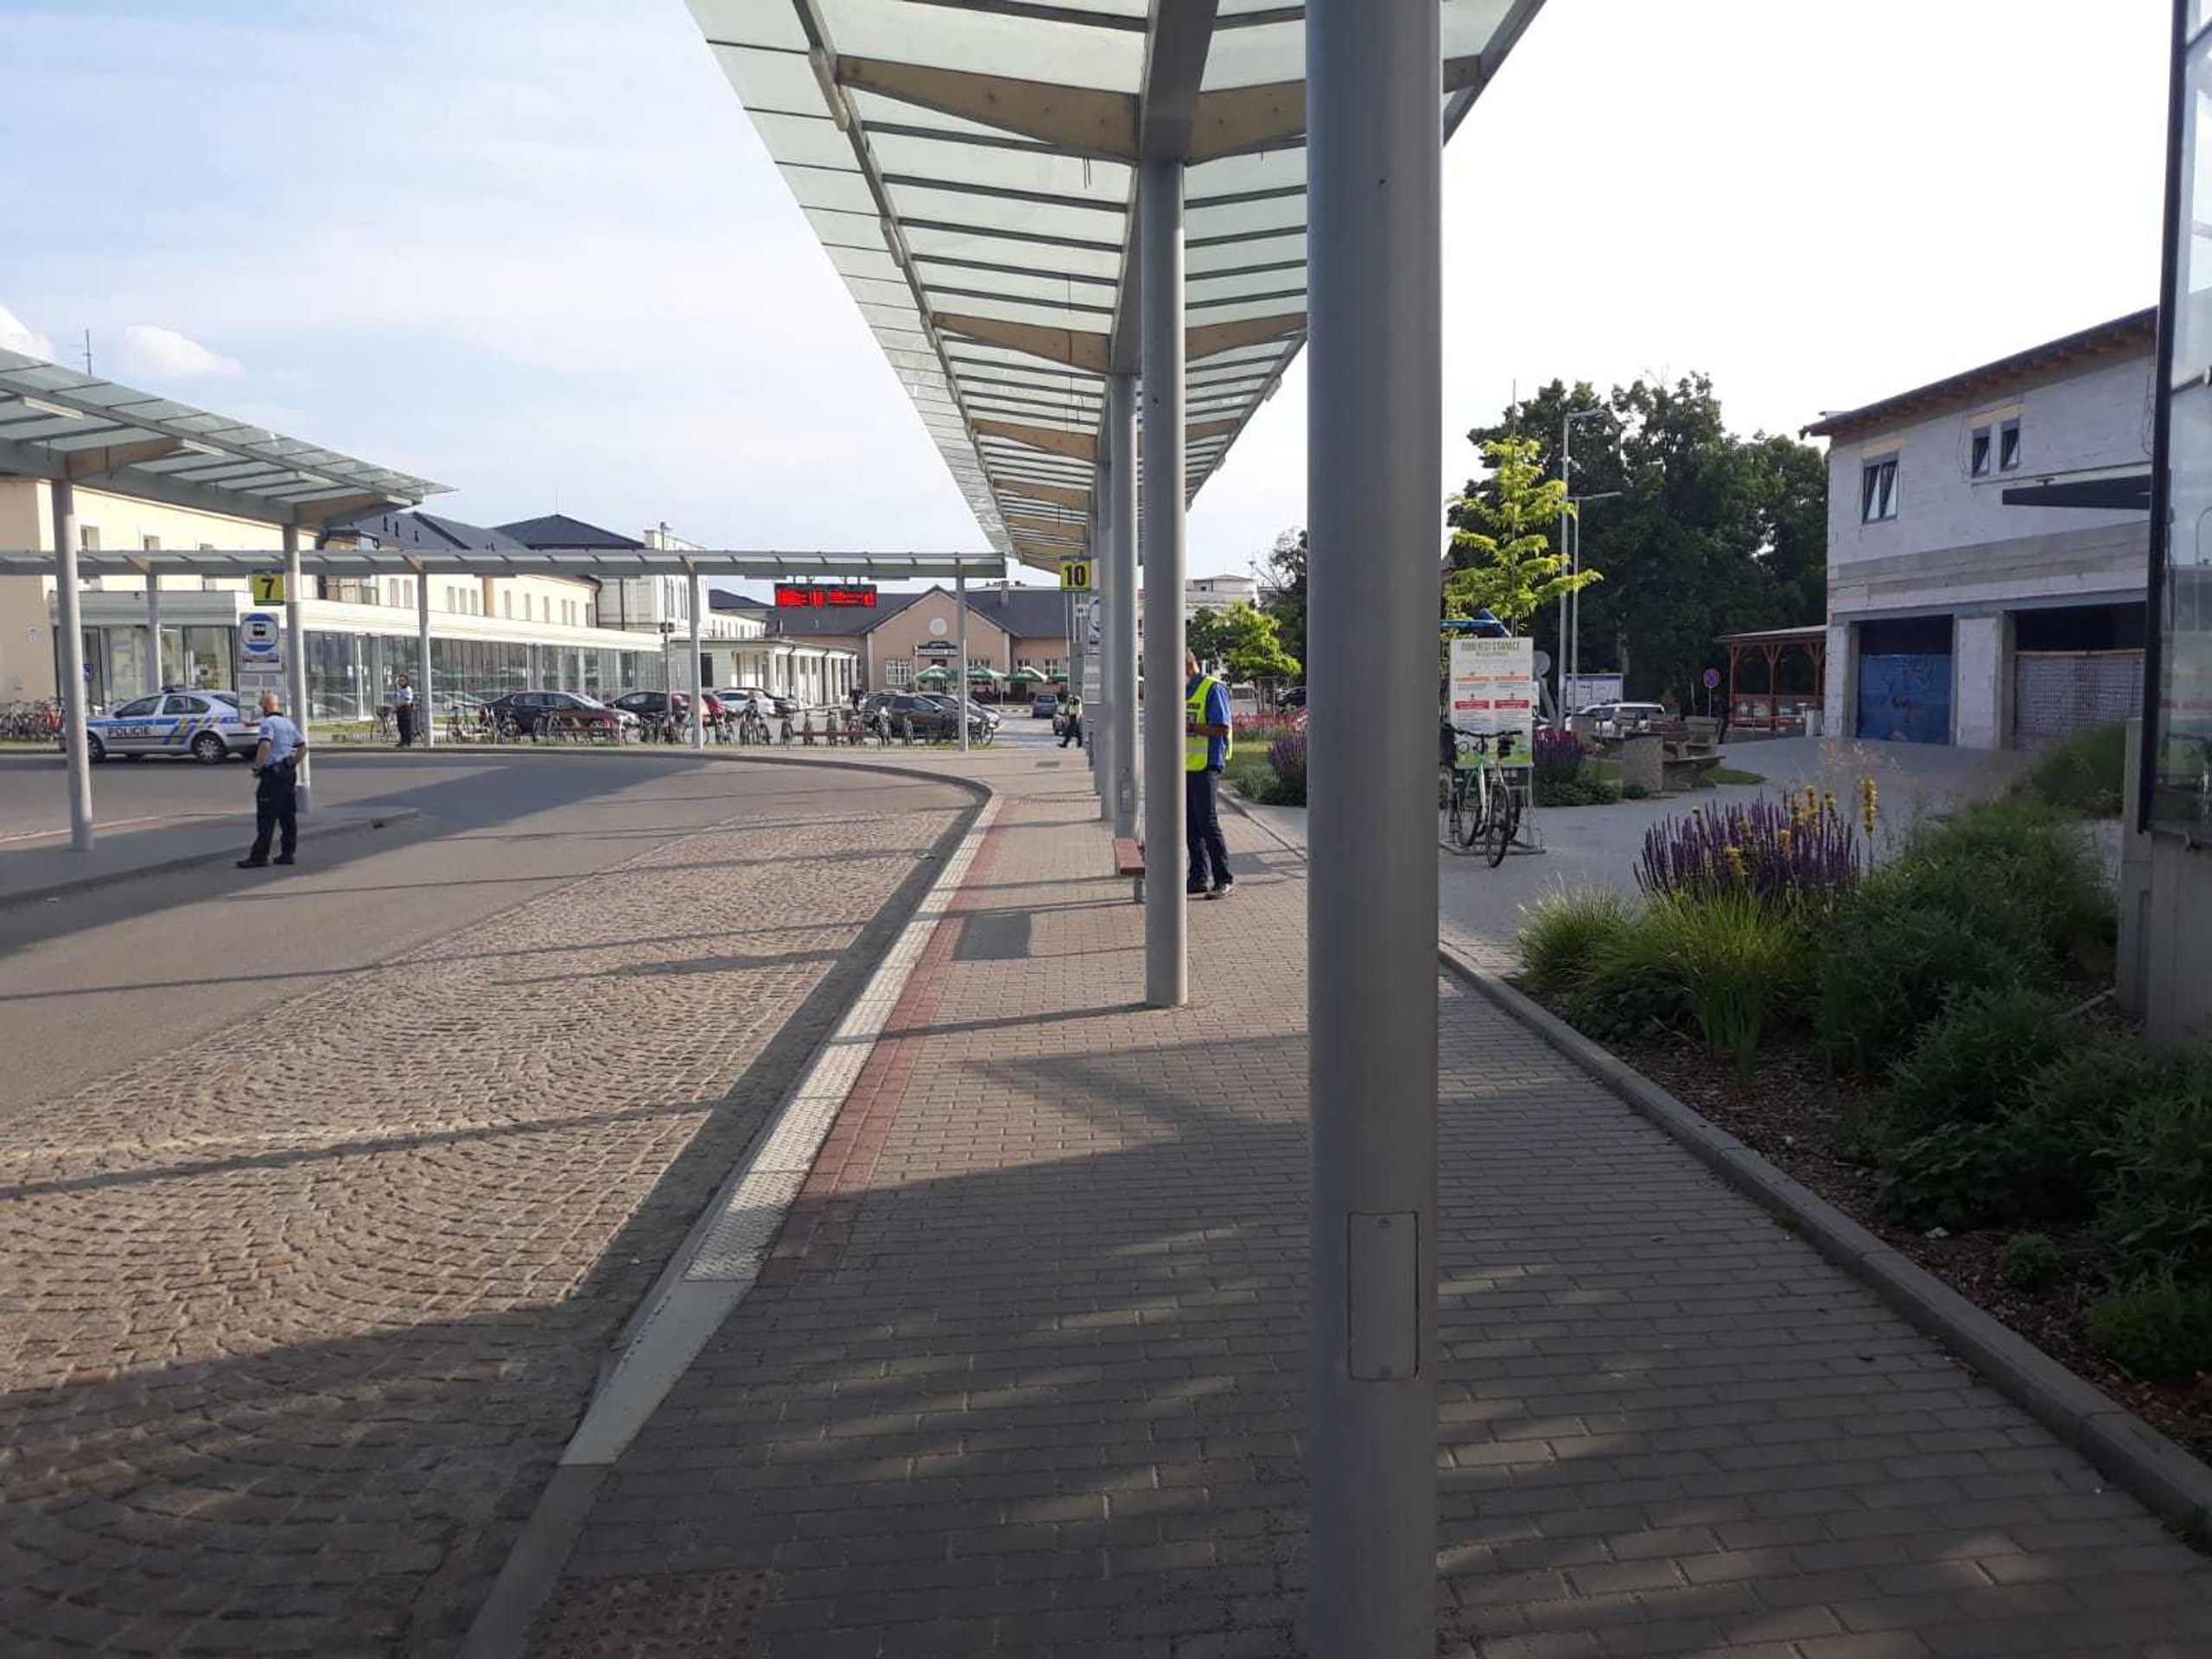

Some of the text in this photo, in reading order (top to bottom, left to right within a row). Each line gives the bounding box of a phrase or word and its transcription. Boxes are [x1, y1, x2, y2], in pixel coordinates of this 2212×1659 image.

[1064, 564, 1086, 587] 10
[260, 578, 275, 600] 7
[107, 727, 152, 737] POLICIE
